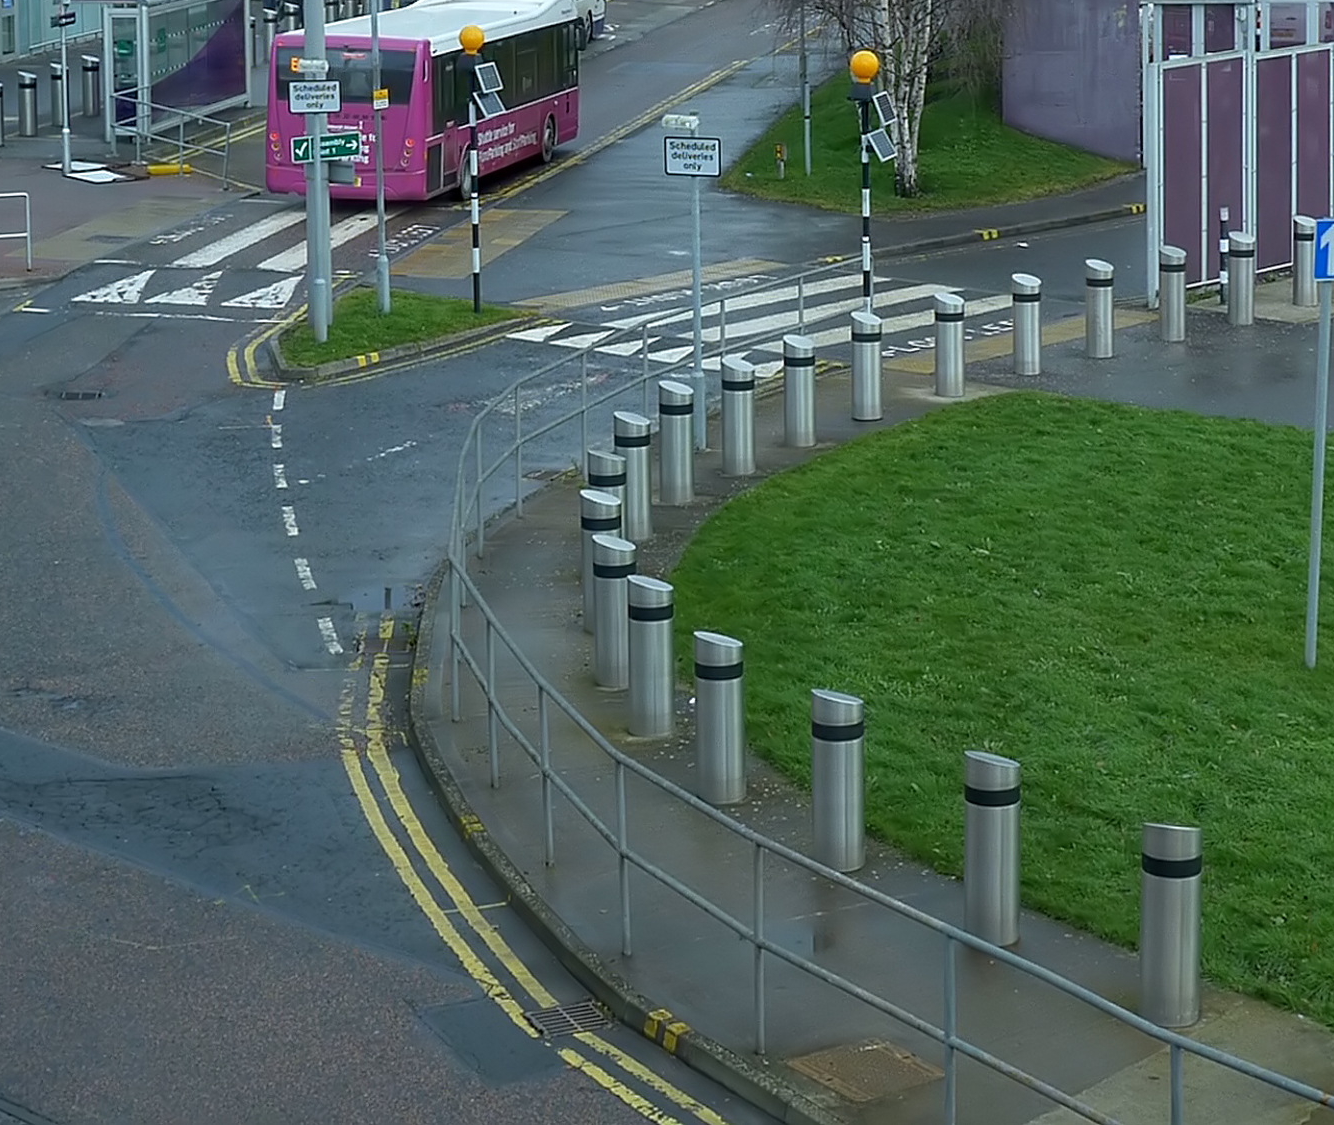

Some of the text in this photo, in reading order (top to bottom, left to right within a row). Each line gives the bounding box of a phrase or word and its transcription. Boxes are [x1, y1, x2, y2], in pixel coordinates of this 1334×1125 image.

[292, 83, 337, 92] Scheduled
[294, 92, 335, 101] deliveries
[306, 101, 325, 109] only
[669, 140, 716, 151] Scheduled
[671, 151, 714, 161] deliveries
[683, 162, 702, 172] only
